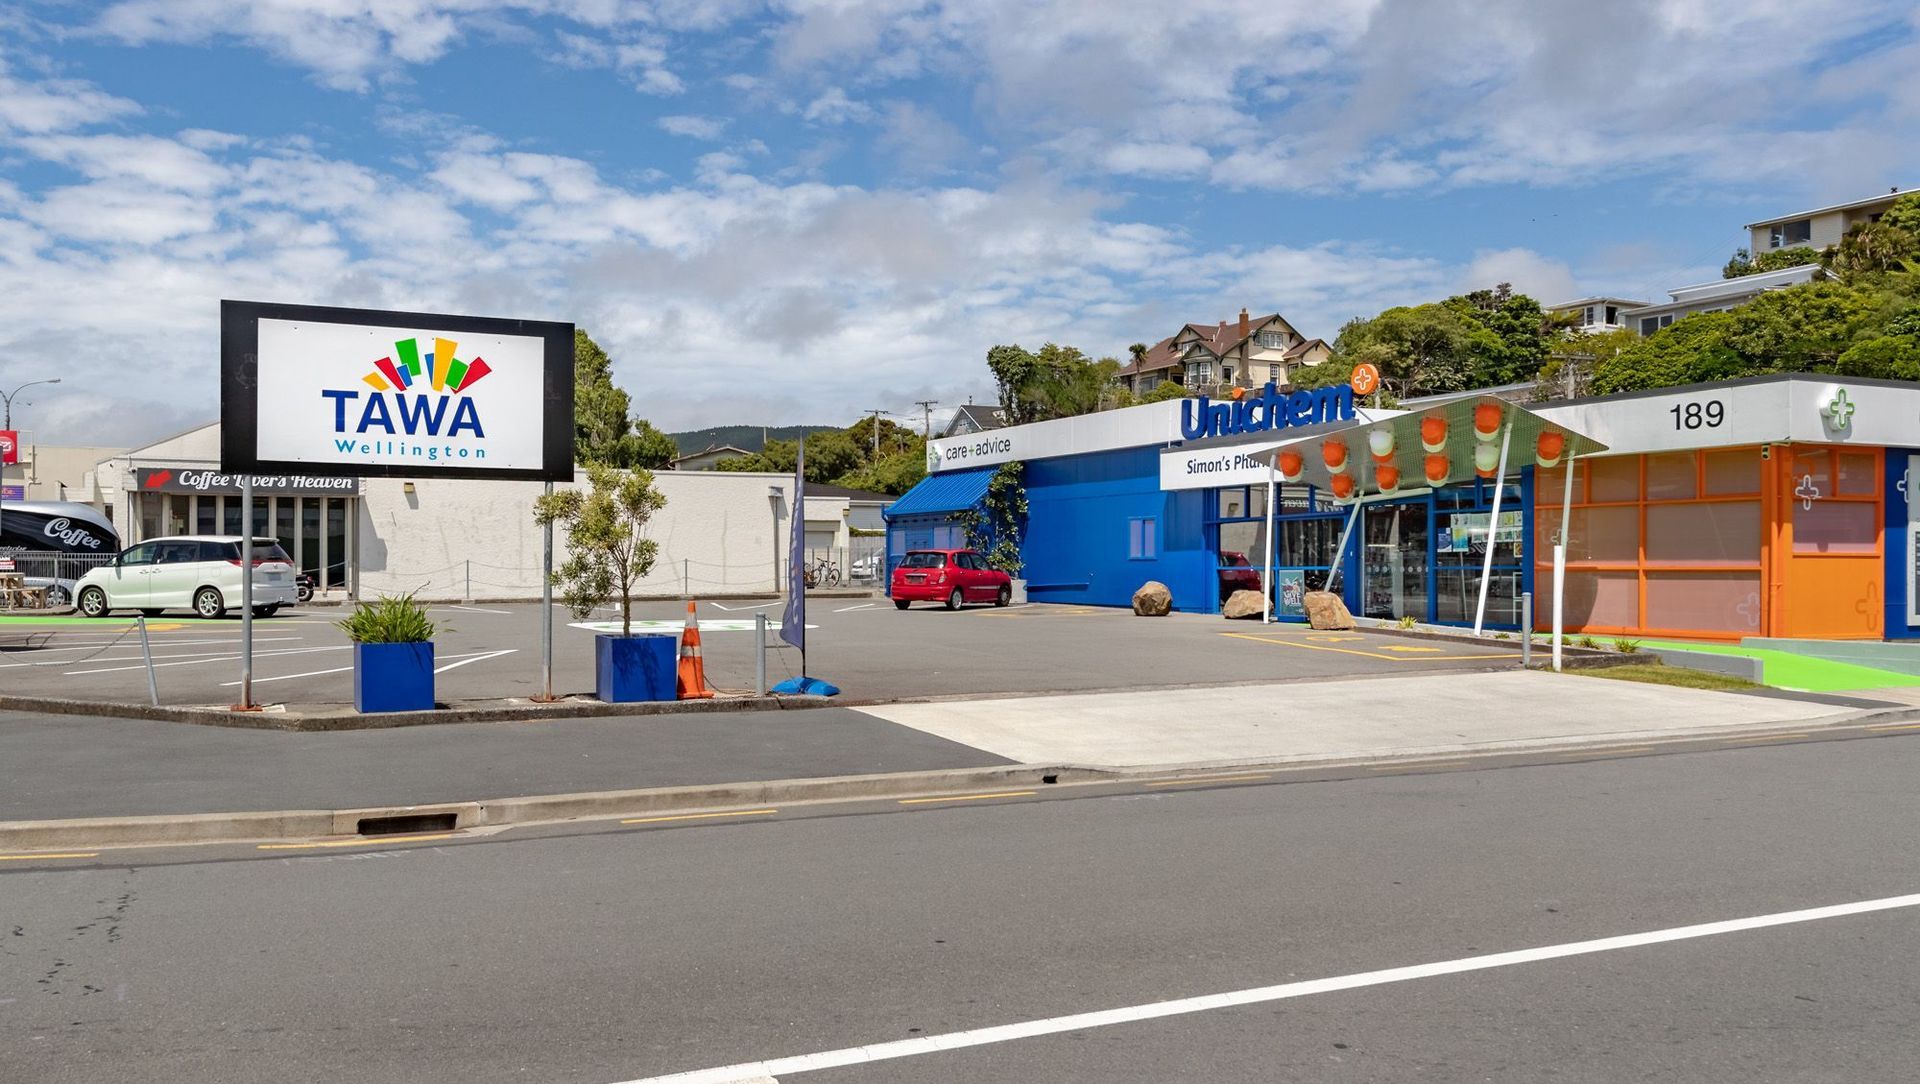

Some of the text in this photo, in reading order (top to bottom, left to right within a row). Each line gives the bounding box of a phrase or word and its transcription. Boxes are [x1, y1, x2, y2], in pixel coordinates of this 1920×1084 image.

[322, 389, 485, 438] TAWA
[1182, 382, 1356, 440] Unichem
[1670, 400, 1724, 430] 189
[335, 439, 485, 460] Wellington
[1187, 456, 1230, 474] Simon's
[179, 471, 353, 490] Coffee Lver's Heaven
[44, 518, 101, 548] Coffee
